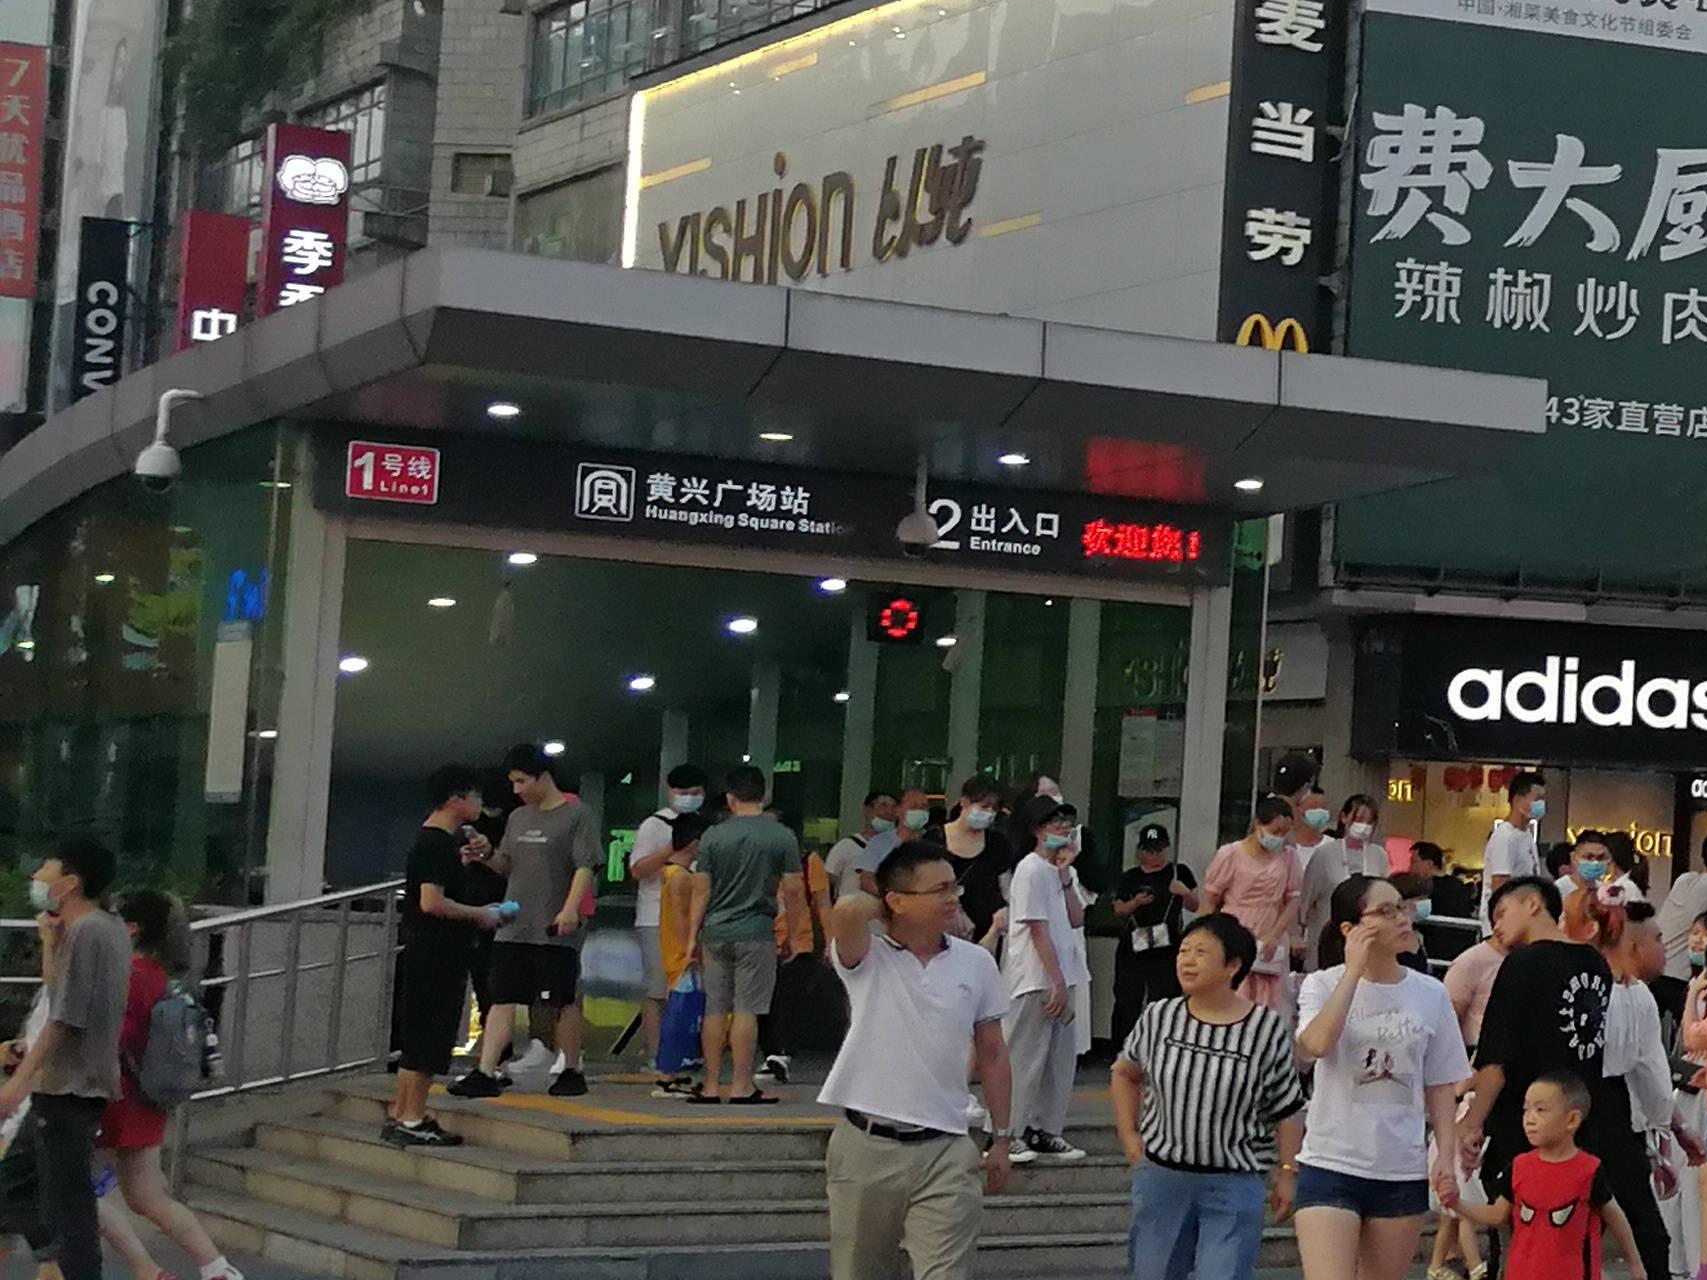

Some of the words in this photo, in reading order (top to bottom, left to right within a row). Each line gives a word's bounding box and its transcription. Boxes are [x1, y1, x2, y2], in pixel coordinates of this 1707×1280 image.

[354, 452, 432, 491] 1号线
[645, 472, 811, 516] 黄兴广场站
[645, 505, 735, 528] Huangxing
[737, 512, 795, 532] Square
[929, 499, 962, 550] 2
[970, 504, 1060, 539] 出入口
[970, 536, 1042, 557] Entrance
